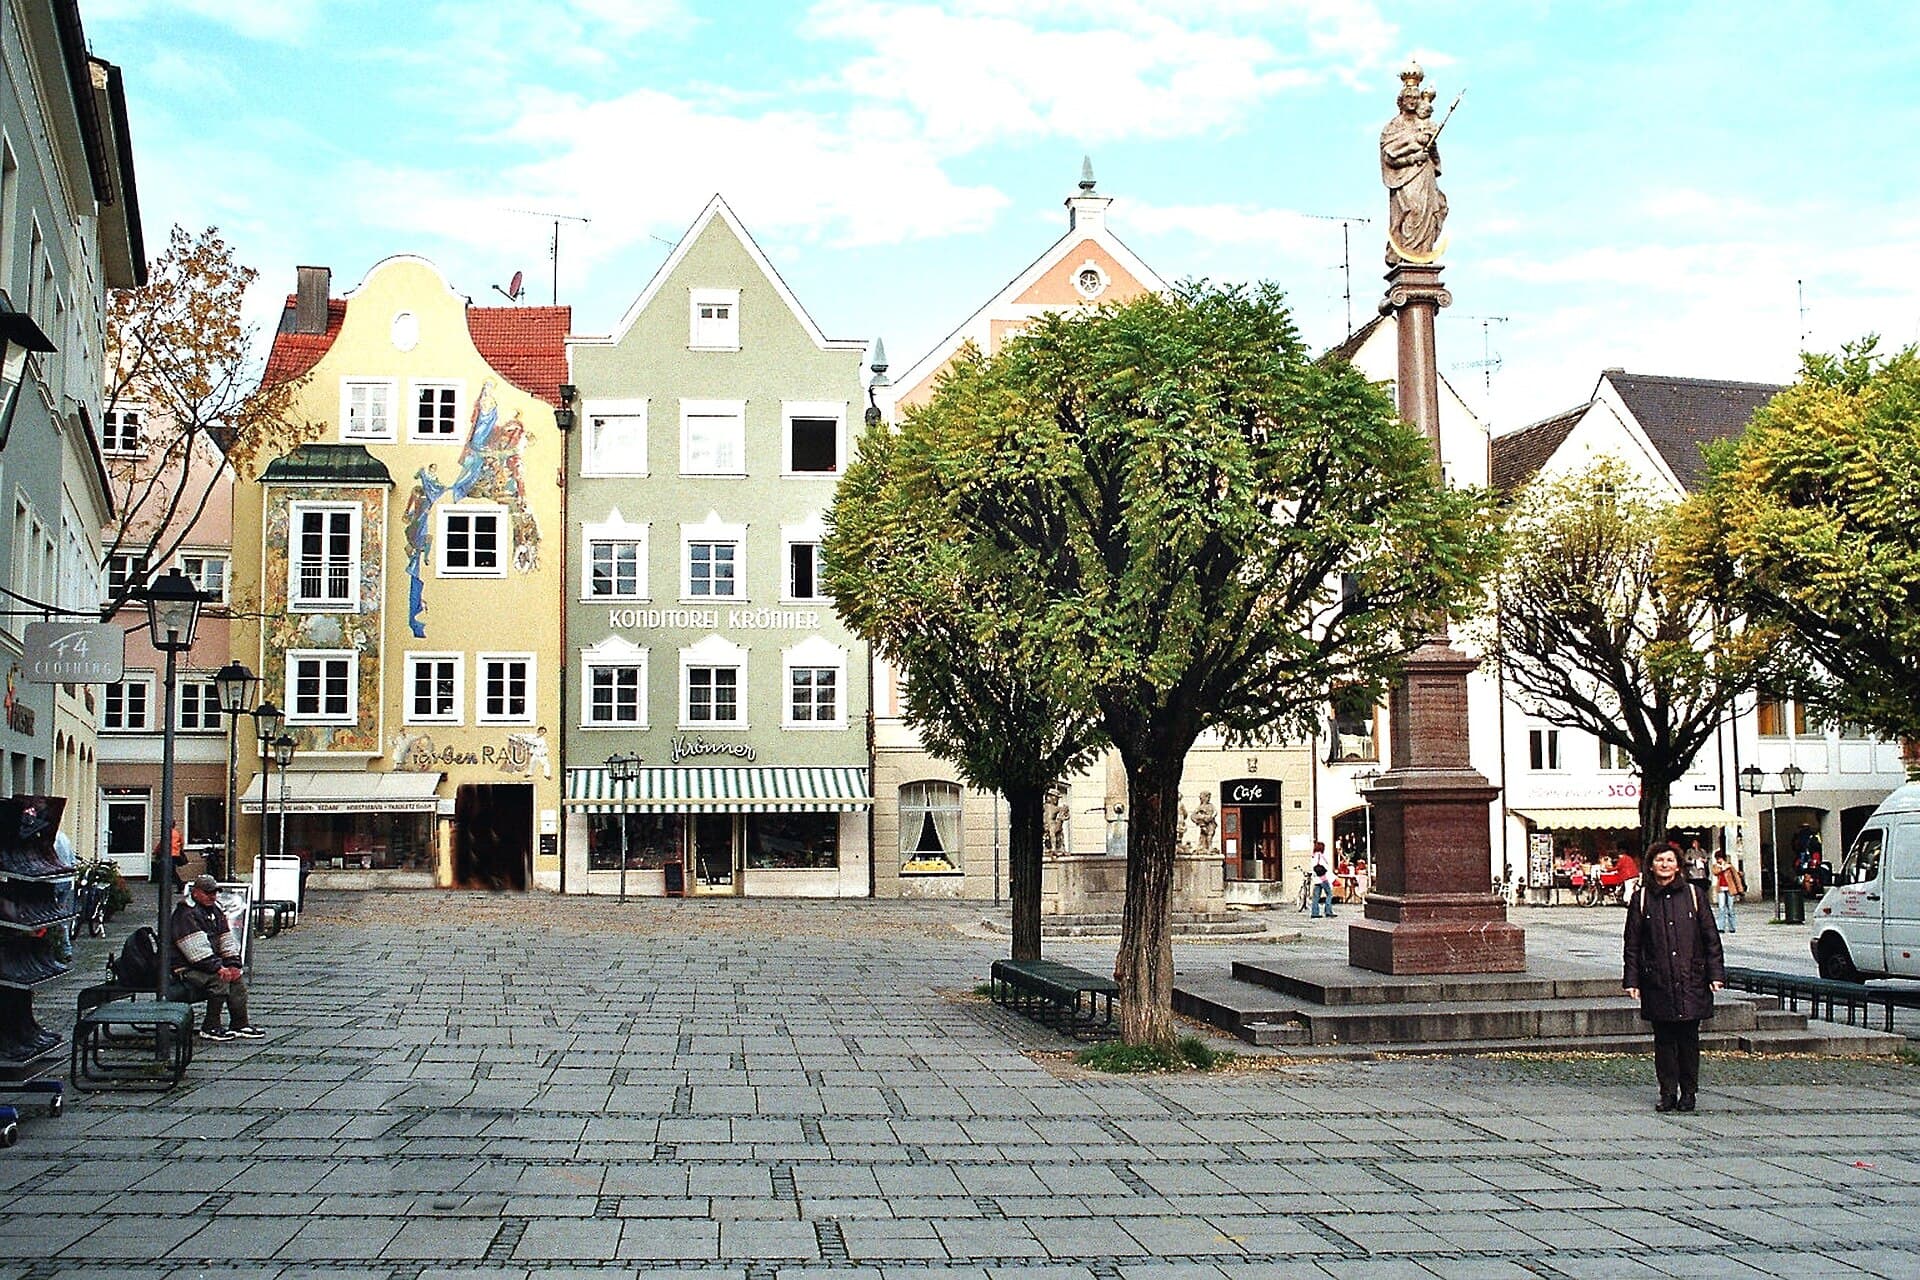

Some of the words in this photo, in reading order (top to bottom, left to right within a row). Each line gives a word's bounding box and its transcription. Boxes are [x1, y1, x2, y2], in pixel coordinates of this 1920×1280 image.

[609, 609, 719, 629] KONDITOREI
[728, 607, 821, 629] KRÖNNER
[35, 661, 111, 674] CLOTHING
[482, 745, 526, 765] RAU
[671, 735, 756, 763] Krönner
